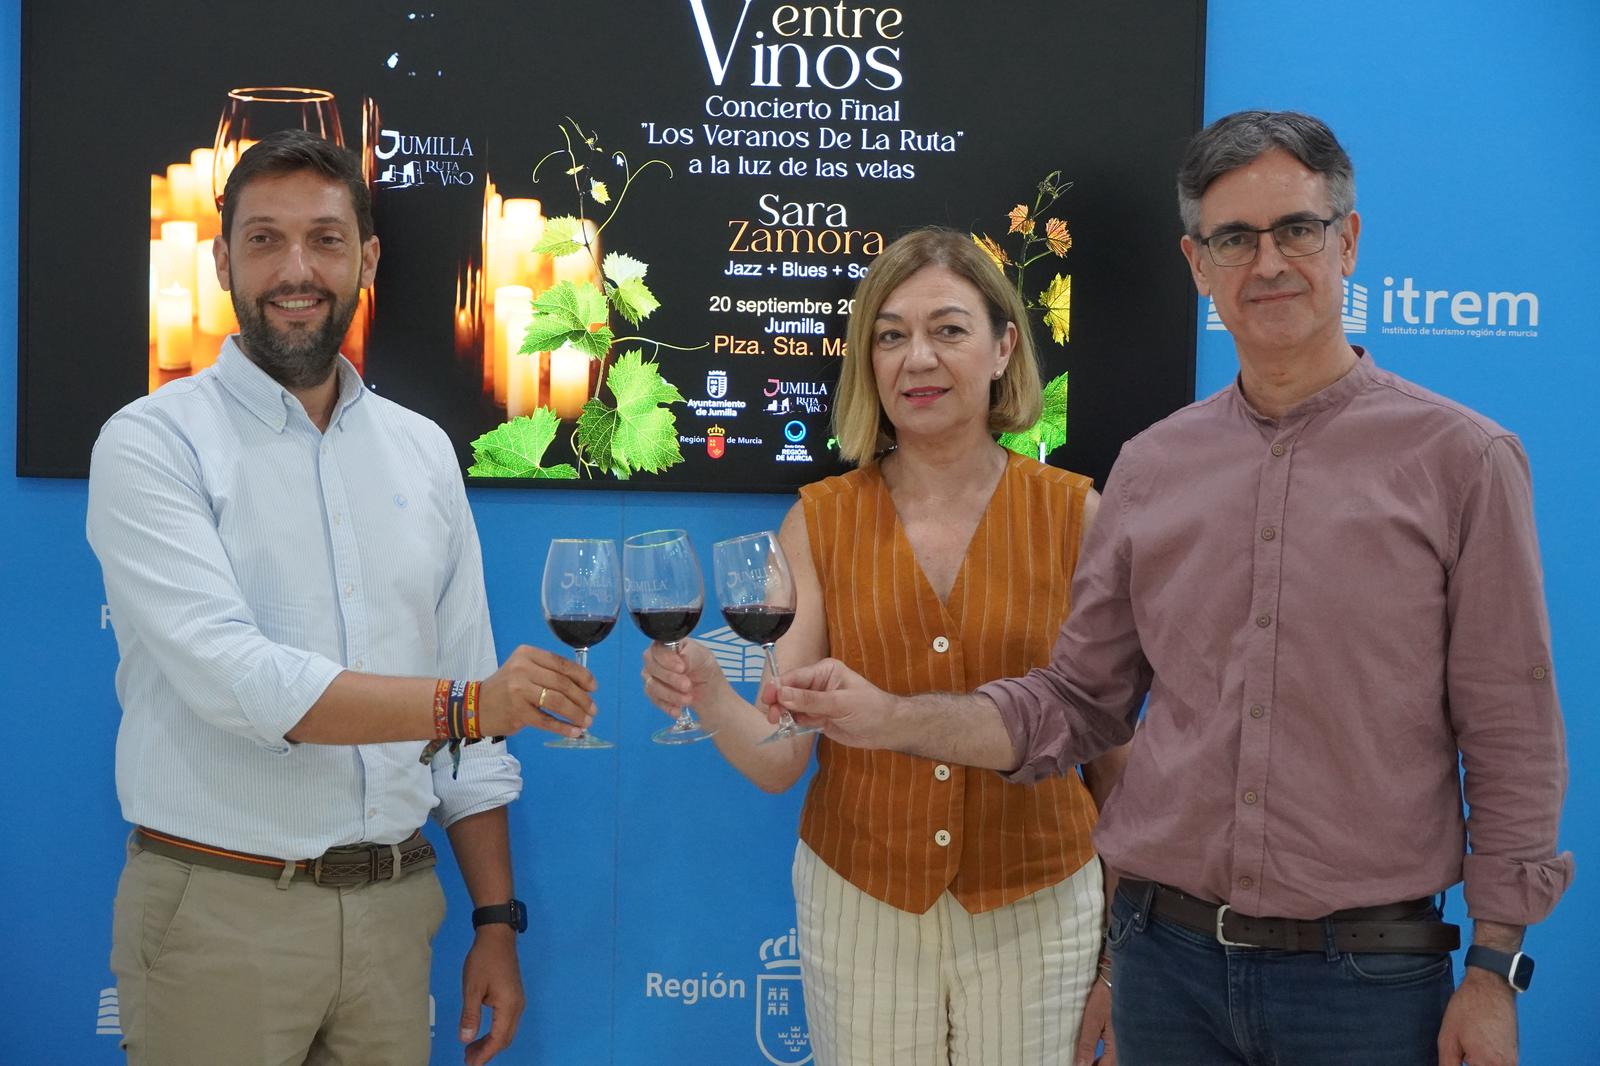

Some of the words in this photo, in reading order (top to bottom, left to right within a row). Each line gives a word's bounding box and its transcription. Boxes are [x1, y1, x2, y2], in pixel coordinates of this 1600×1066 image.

[773, 0, 904, 39] entre
[706, 96, 831, 119] Concierto
[841, 99, 899, 121] Final
[375, 129, 474, 160] JUMILLA
[703, 124, 809, 148] Veranos
[819, 128, 851, 149] De
[862, 129, 890, 150] La
[426, 160, 460, 173] RUTA
[689, 159, 702, 173] a
[711, 155, 730, 174] la
[739, 156, 771, 174] luz
[779, 158, 807, 176] de
[816, 158, 848, 177] las
[856, 160, 915, 179] velas
[758, 194, 848, 227] Sara
[728, 220, 884, 255] Zamora
[725, 261, 762, 276] Jazz
[783, 262, 827, 277] Blues
[848, 263, 869, 278] So
[710, 296, 731, 312] 20
[737, 298, 832, 316] septiembre
[1383, 276, 1539, 326] itrem
[765, 317, 824, 334] Jumilla
[1381, 326, 1417, 335] instituto
[1432, 327, 1465, 336] turismo
[1467, 327, 1494, 338] región
[1508, 329, 1538, 338] murcia
[714, 335, 765, 355] Plza.
[773, 336, 814, 356] Sta.
[823, 338, 848, 357] Ma
[763, 378, 828, 397] JUMILLA
[687, 399, 747, 409] Ayuntamiento
[796, 396, 819, 405] RUTA
[695, 408, 708, 416] de
[708, 409, 738, 417] Jumilla
[680, 436, 706, 445] Región
[738, 437, 763, 445] Murcia
[787, 454, 813, 462] MURCIA
[647, 972, 745, 1004] Región
